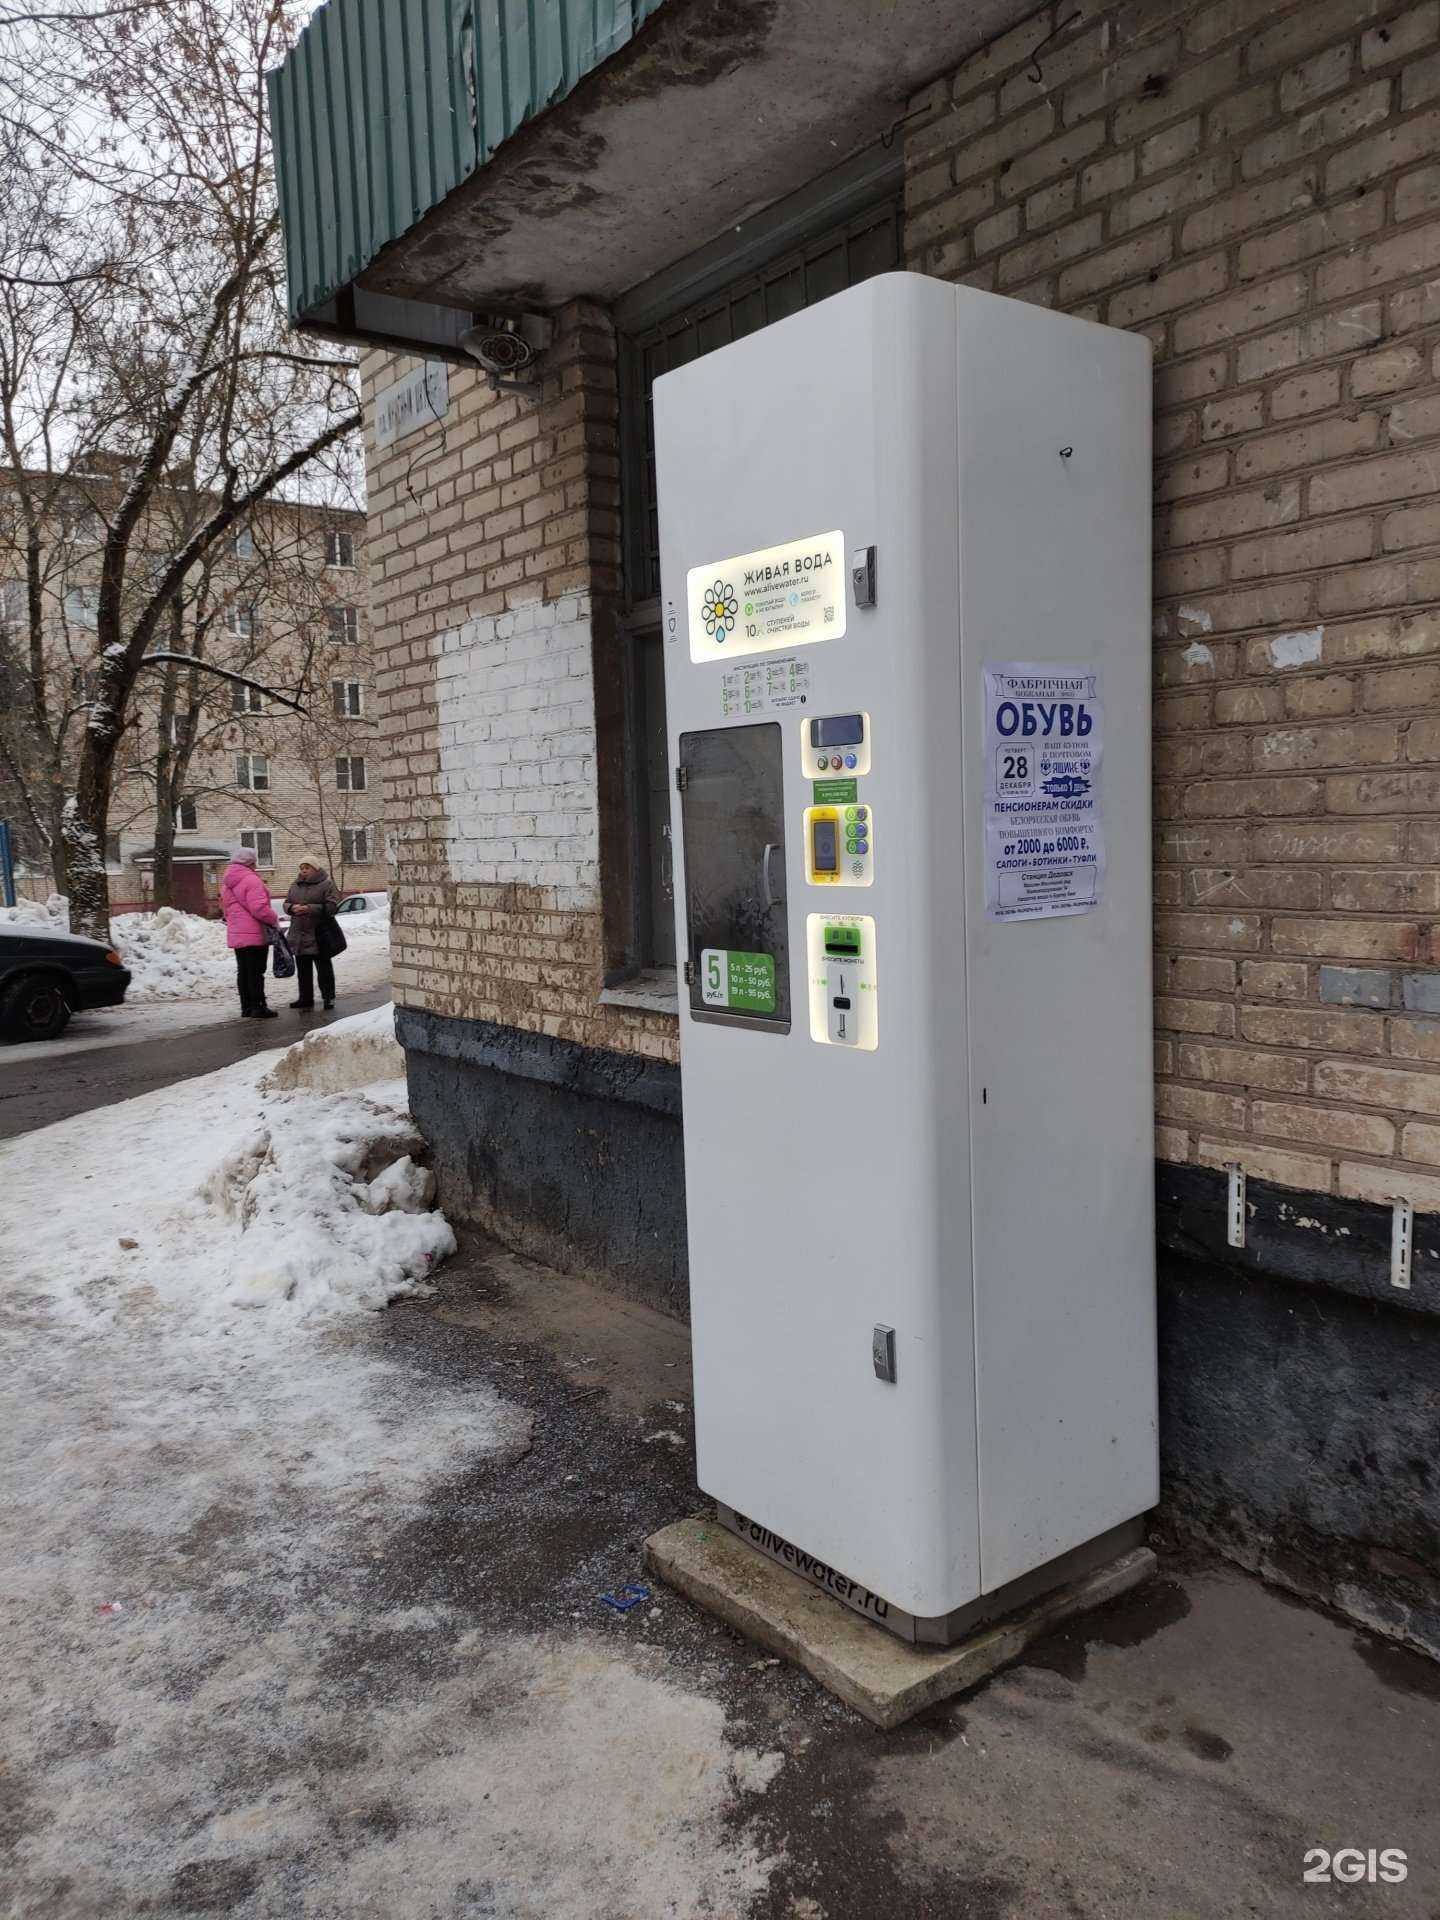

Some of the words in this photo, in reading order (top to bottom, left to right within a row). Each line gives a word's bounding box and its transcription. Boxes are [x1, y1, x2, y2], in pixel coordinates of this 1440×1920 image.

[744, 562, 790, 586] ЖИВАЯ
[795, 552, 832, 573] ВОДА
[744, 576, 809, 597] www.alivewater.ru
[745, 624, 757, 638] 10
[766, 667, 772, 681] 3
[789, 663, 795, 677] 4
[744, 671, 750, 684] 2
[1007, 679, 1083, 689] ФАБРИЧНАЯ
[996, 701, 1093, 736] ОБУВЬ
[1003, 756, 1028, 779] 28
[1000, 781, 1031, 790] ДЕКАБРЯ
[994, 801, 1059, 813] ПЕНСИОНЕРАМ
[1060, 799, 1093, 810] СКИДКИ
[1004, 845, 1016, 855] от
[1017, 838, 1041, 854] 2000
[1043, 842, 1055, 854] до
[1057, 836, 1079, 852] 6000
[996, 859, 1028, 869] САПОГИ
[1032, 856, 1068, 867] БОТИНКИ
[1073, 854, 1096, 863] ТУФЛИ
[708, 955, 720, 990] 5
[730, 962, 735, 971] 5
[745, 964, 753, 973] 25
[754, 966, 768, 975] руб.
[731, 975, 738, 983] 10
[748, 977, 757, 985] 50
[758, 977, 771, 987] руб.
[758, 990, 771, 1000] руб.
[750, 1523, 889, 1619] alivewater.ru
